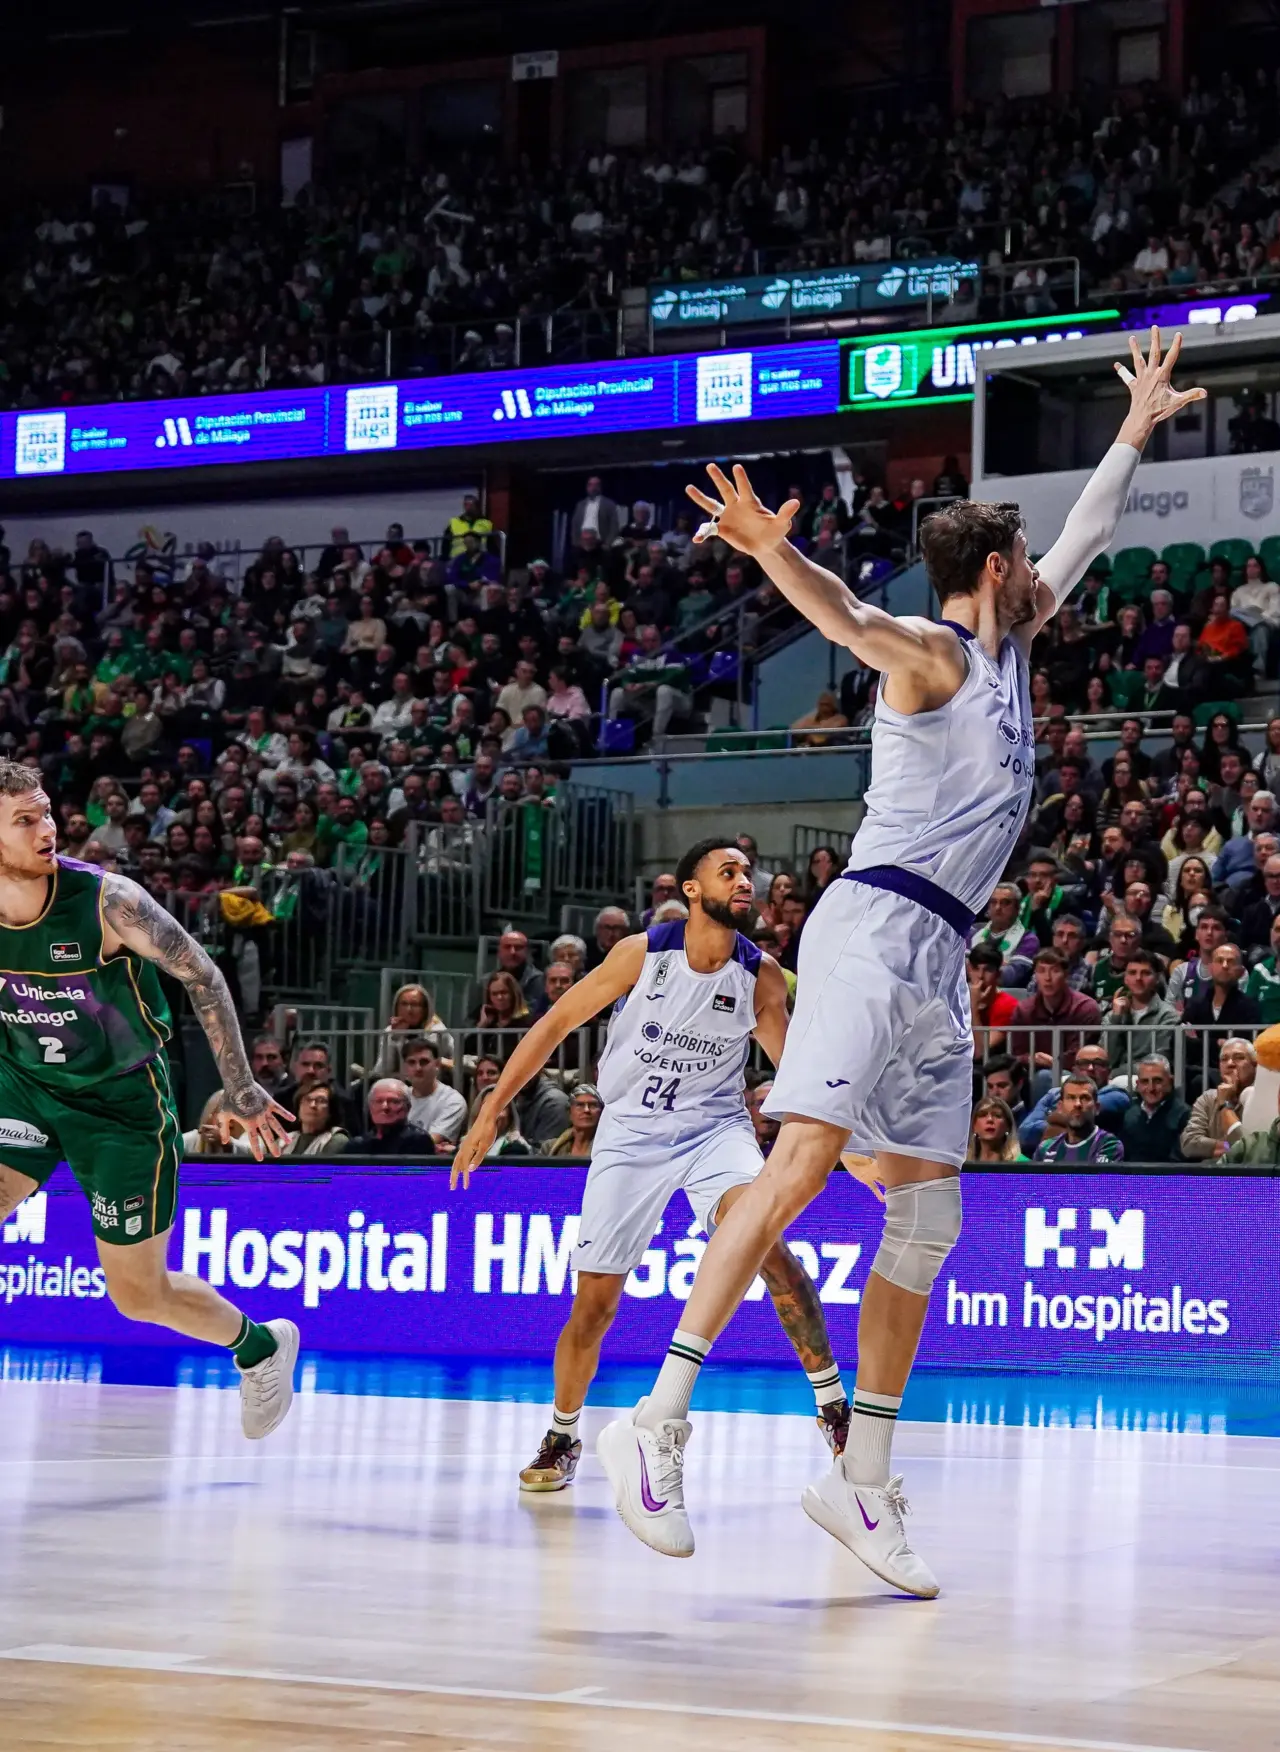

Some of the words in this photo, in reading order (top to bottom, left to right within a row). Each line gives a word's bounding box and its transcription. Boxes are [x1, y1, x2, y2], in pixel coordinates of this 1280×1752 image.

[908, 278, 959, 297] Uncaja
[1125, 489, 1189, 517] laga
[38, 1036, 66, 1063] 2
[663, 1032, 725, 1057] PROBITAS
[641, 1075, 681, 1111] 24
[0, 1126, 47, 1144] madesa
[182, 1207, 447, 1307] Hospital
[946, 1279, 1008, 1327] hm
[1023, 1280, 1230, 1342] hospitales
